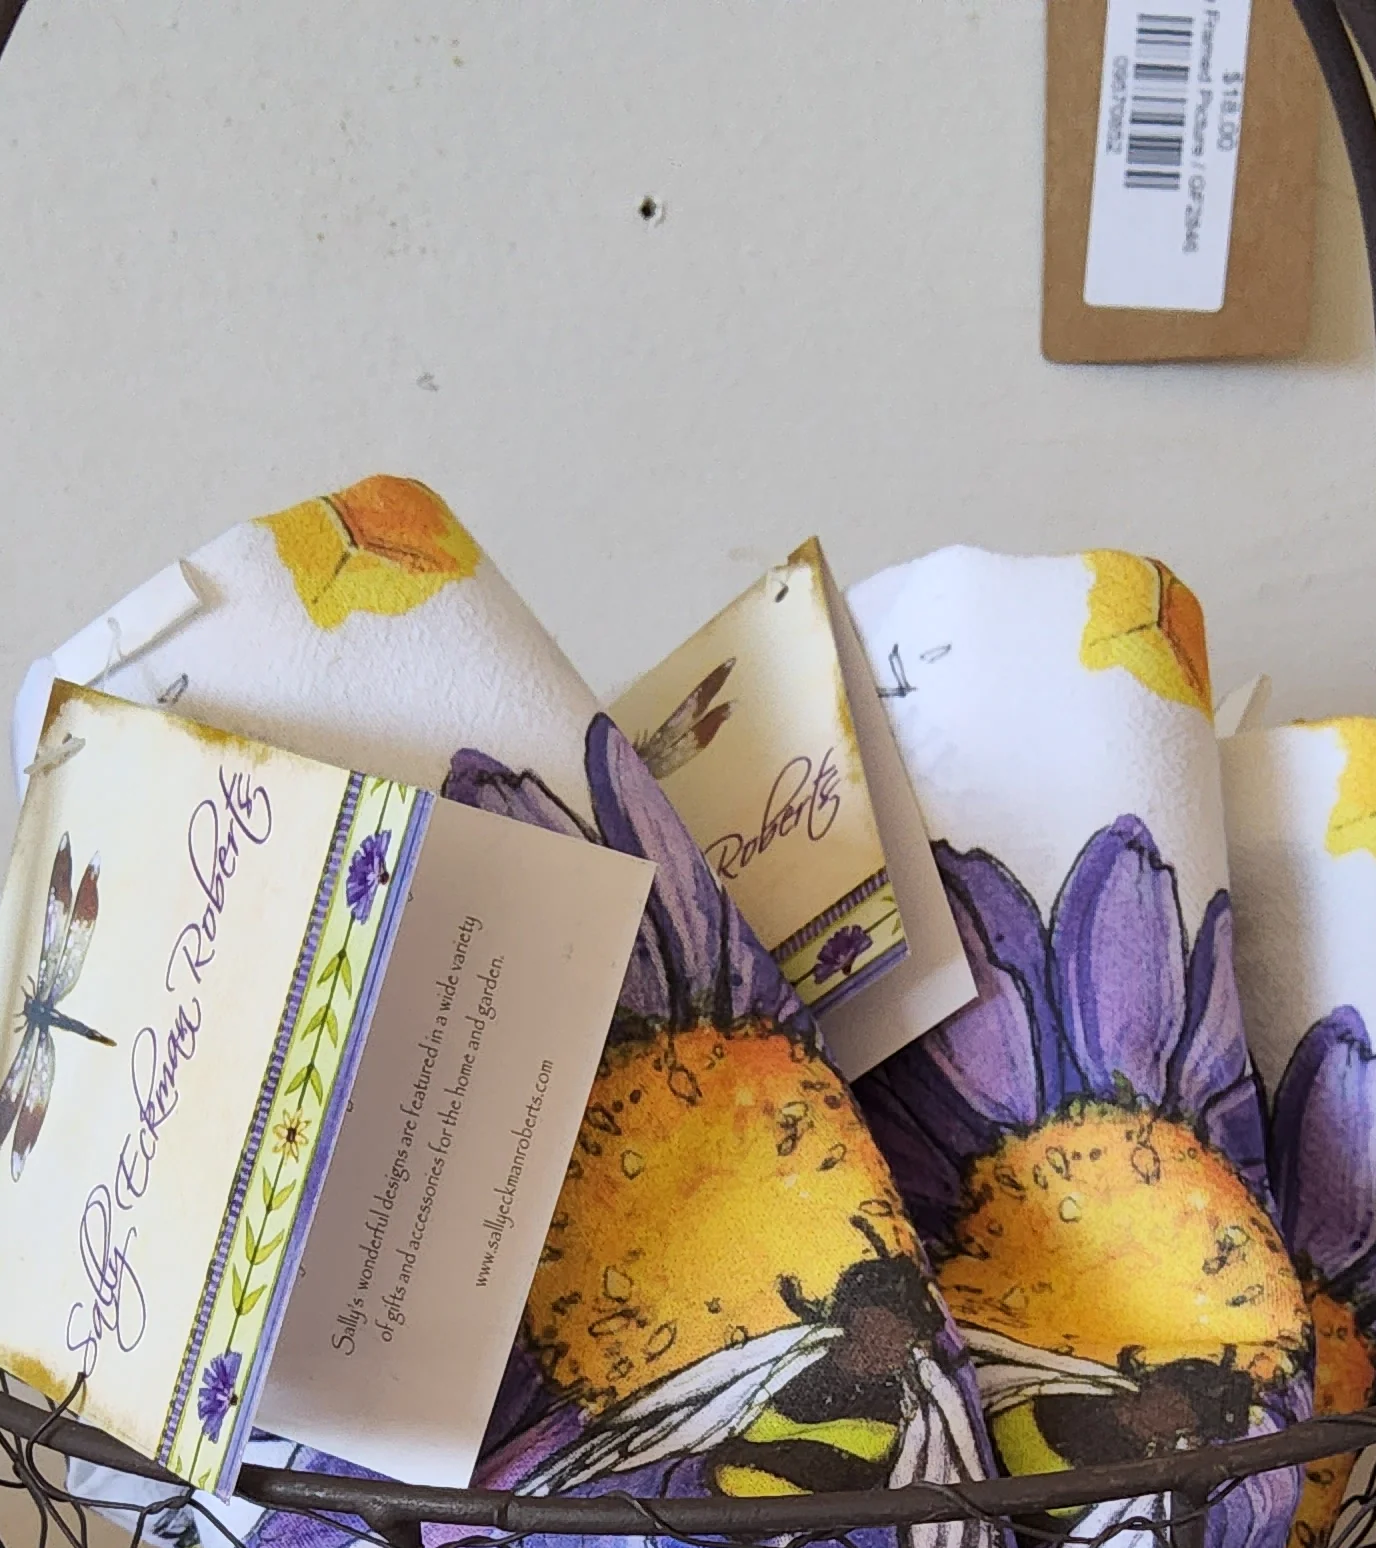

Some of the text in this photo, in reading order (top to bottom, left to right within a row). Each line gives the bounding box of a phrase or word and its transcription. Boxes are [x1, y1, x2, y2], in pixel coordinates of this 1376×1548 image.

[1198, 10, 1222, 82] Framed
[1191, 89, 1214, 157] Picture
[1218, 70, 1244, 152] $18.00
[704, 746, 842, 880] Roberts
[465, 1015, 485, 1051] and
[67, 764, 272, 1378] Sally Eckman Roberts
[444, 1053, 475, 1098] home
[331, 915, 483, 1356] Sally's wonderful designs are featured in a wide variety
[427, 1128, 455, 1156] for
[437, 1100, 462, 1127] the
[409, 1156, 445, 1251] accessories
[476, 1059, 554, 1288] www.sallyeckmanroberts.com
[396, 1248, 417, 1284] and
[375, 1319, 394, 1342] of
[381, 1285, 406, 1326] gifts
